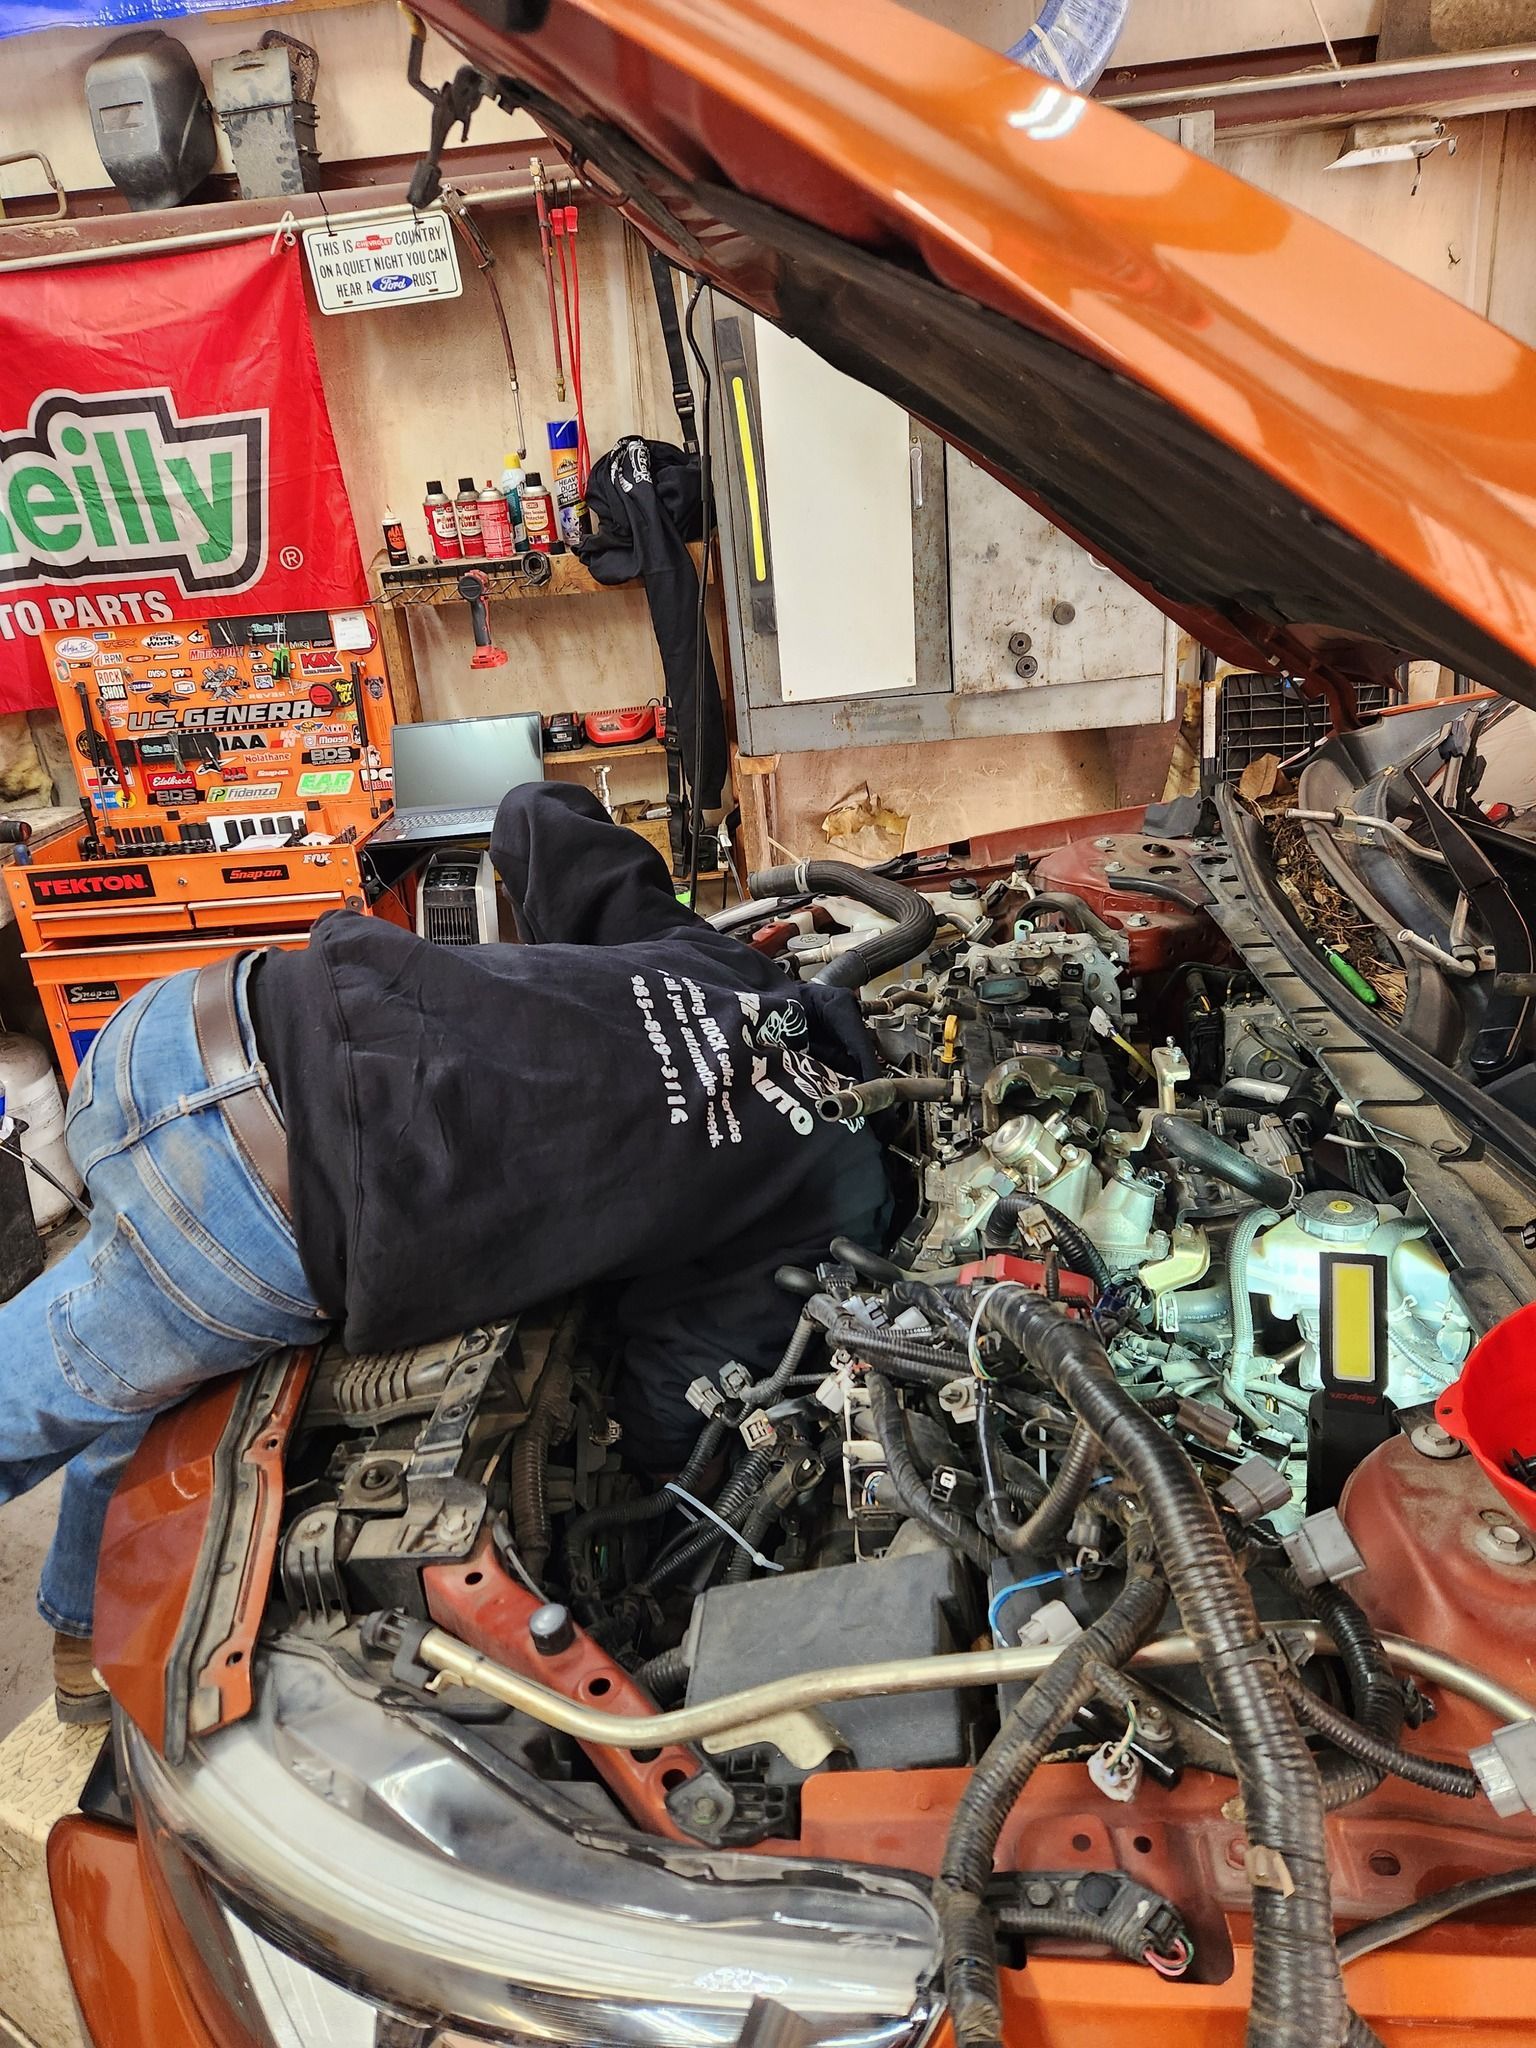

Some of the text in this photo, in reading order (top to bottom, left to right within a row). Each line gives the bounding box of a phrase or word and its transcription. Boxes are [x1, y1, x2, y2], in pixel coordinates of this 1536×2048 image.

[316, 225, 442, 257] THIS IS CHEVROLET COUNTRY
[320, 247, 448, 278] ON A QUIET NIGHT YOU CAN
[336, 271, 439, 298] HEAR A Ford RUST
[0, 589, 174, 640] TO PARTS
[103, 654, 122, 663] RPM
[97, 671, 121, 684] ROCK
[128, 710, 180, 731] U.S.
[221, 735, 266, 751] IAA
[245, 753, 290, 763] Nolathane
[311, 747, 351, 760] BDS
[157, 788, 197, 801] BDS
[228, 787, 277, 798] fidanza
[303, 853, 333, 864] FOX
[230, 869, 282, 880] Snap-on
[35, 874, 146, 896] TEKTON
[663, 977, 682, 991] all
[70, 986, 116, 1002] Snap-on
[667, 993, 688, 1024] your
[631, 975, 688, 1124] 985-809-3116
[680, 1026, 718, 1096] automotive
[681, 977, 742, 1143] oviding ROCK solid service
[707, 1101, 724, 1148] needs
